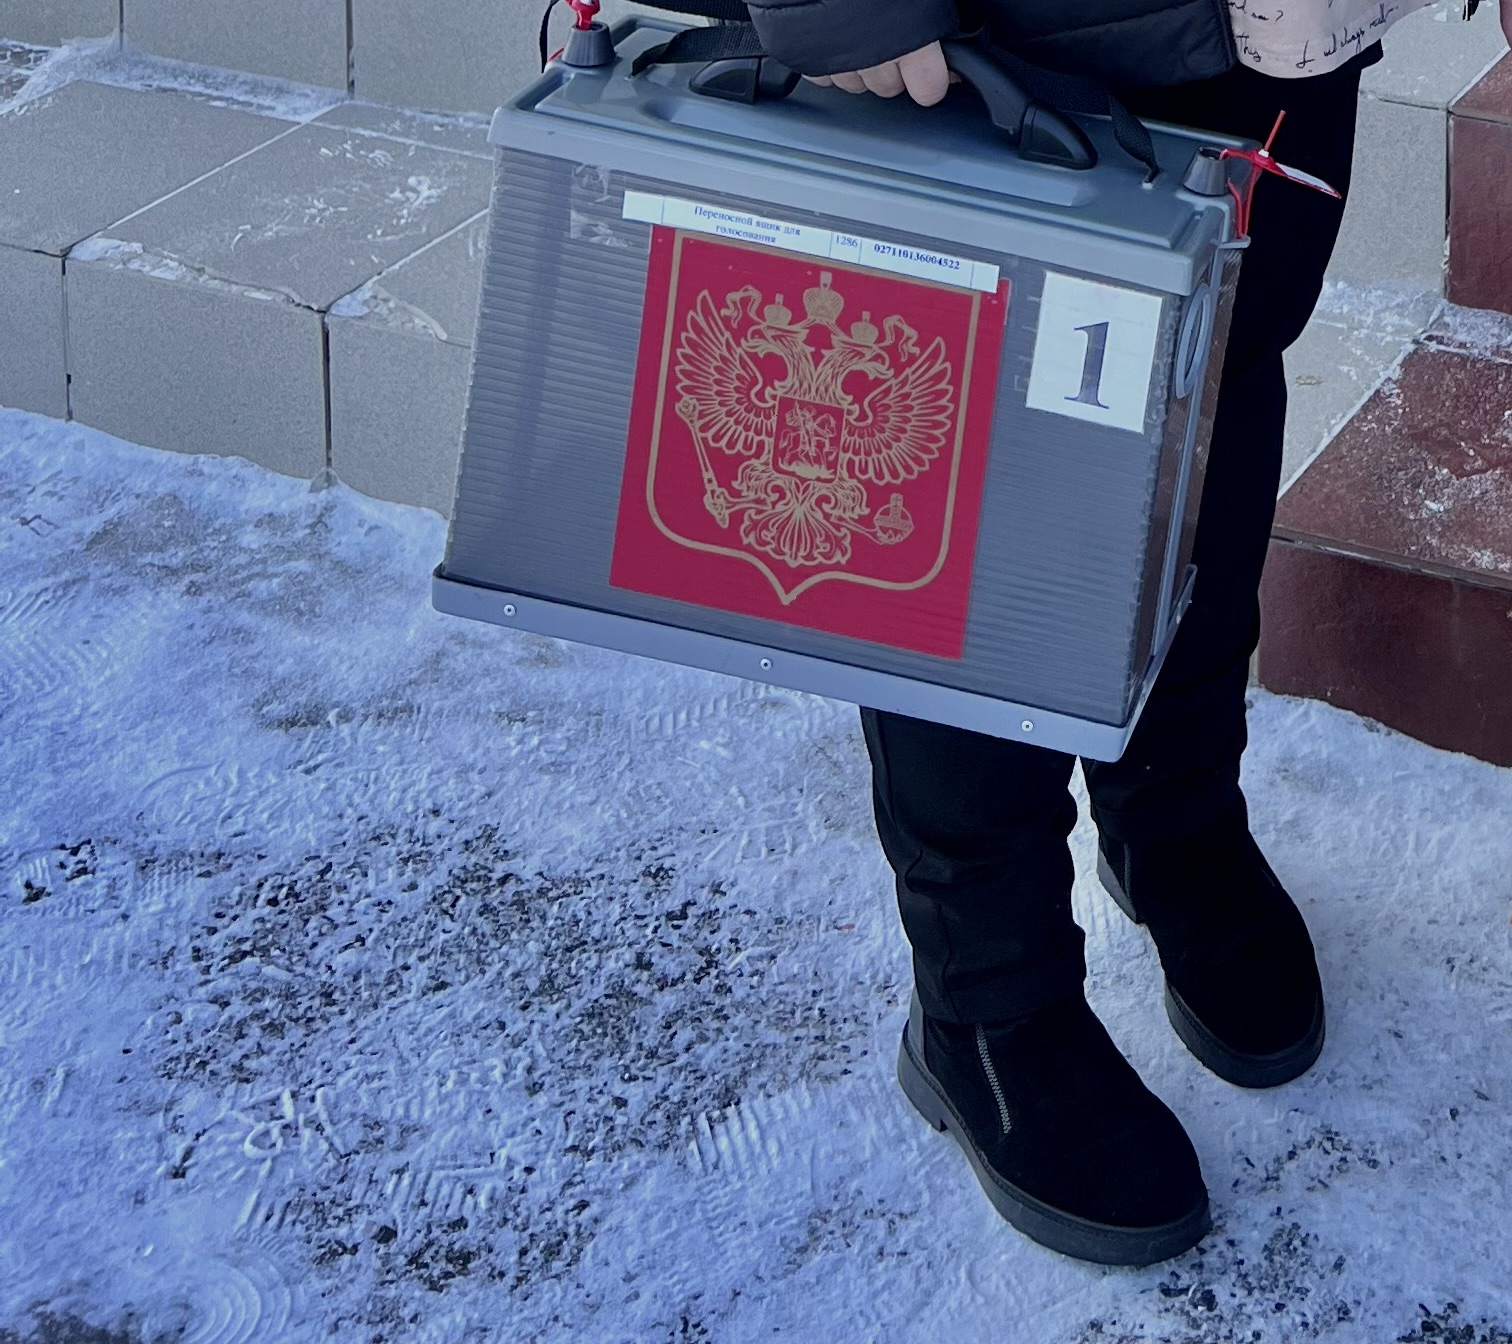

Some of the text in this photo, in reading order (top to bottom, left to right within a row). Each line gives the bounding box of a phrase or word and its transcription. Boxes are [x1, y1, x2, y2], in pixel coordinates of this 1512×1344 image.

[694, 206, 801, 237] Переносной ящик для
[715, 224, 777, 244] голосования
[835, 234, 858, 248] 1286
[874, 243, 960, 270] 027110136004522
[1064, 321, 1110, 410] 1
